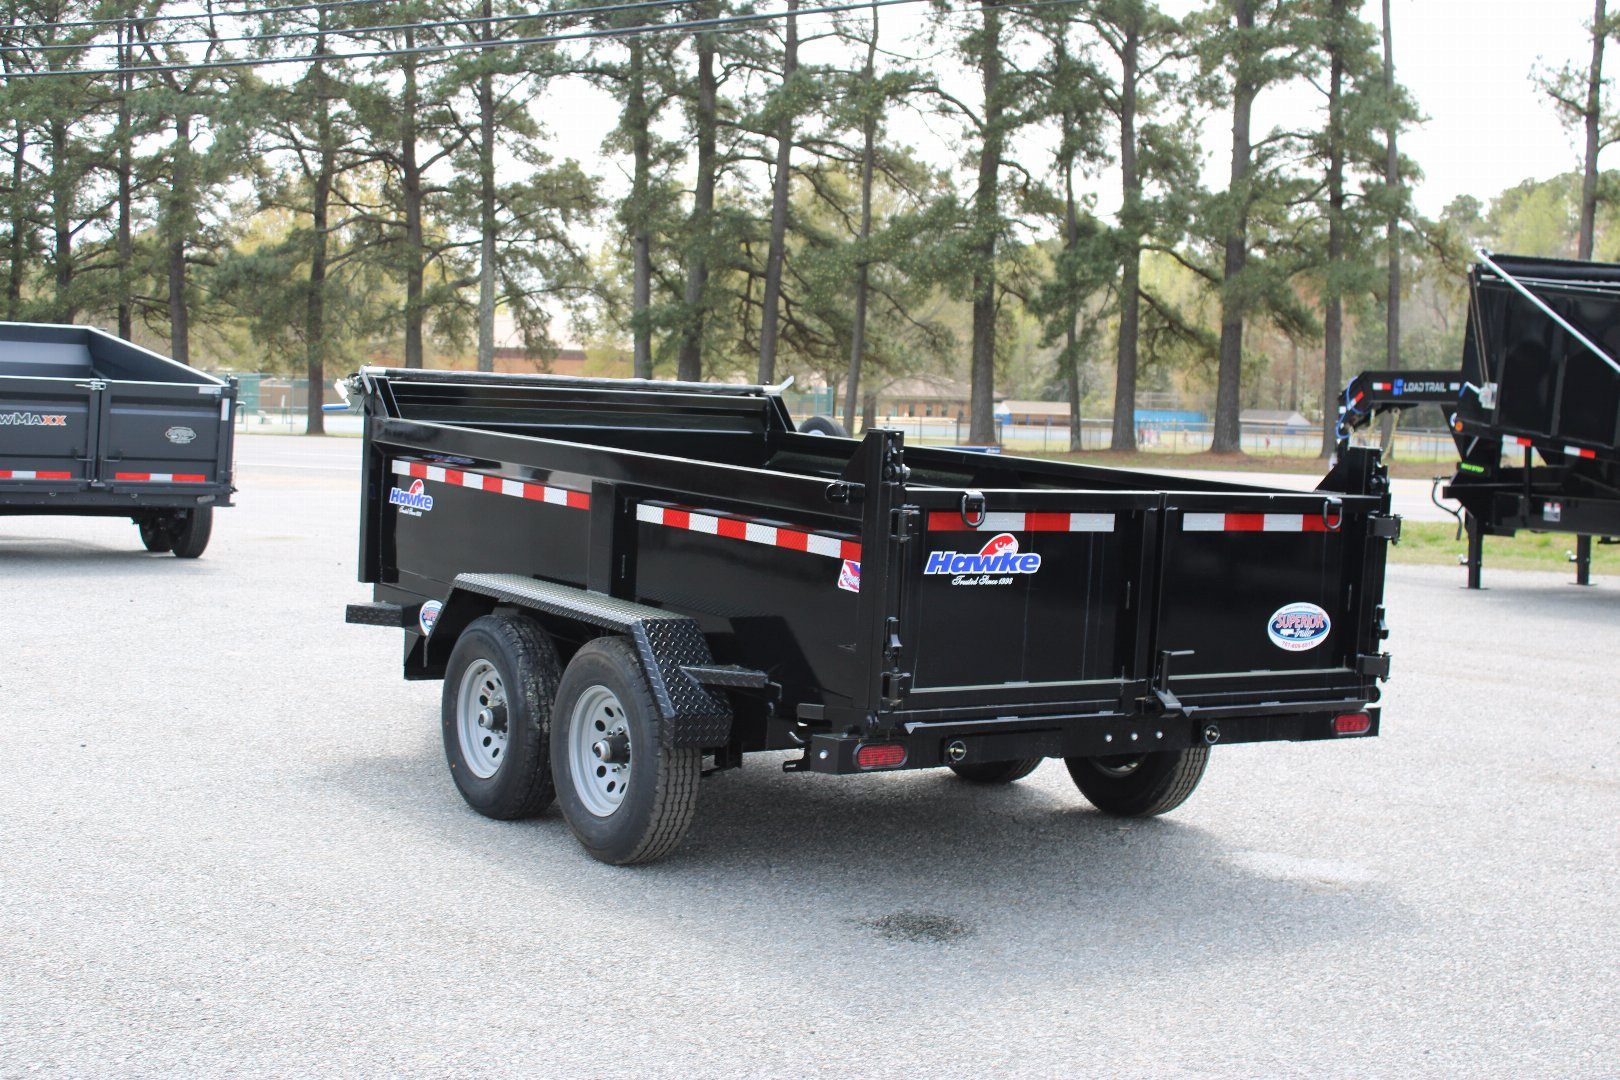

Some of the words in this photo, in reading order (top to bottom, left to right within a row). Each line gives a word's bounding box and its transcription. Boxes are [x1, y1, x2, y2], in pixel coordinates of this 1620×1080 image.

[389, 486, 434, 511] Hawke
[924, 551, 1041, 575] Hawke
[951, 575, 979, 586] Trusted
[1275, 611, 1325, 629] SUPERIOR
